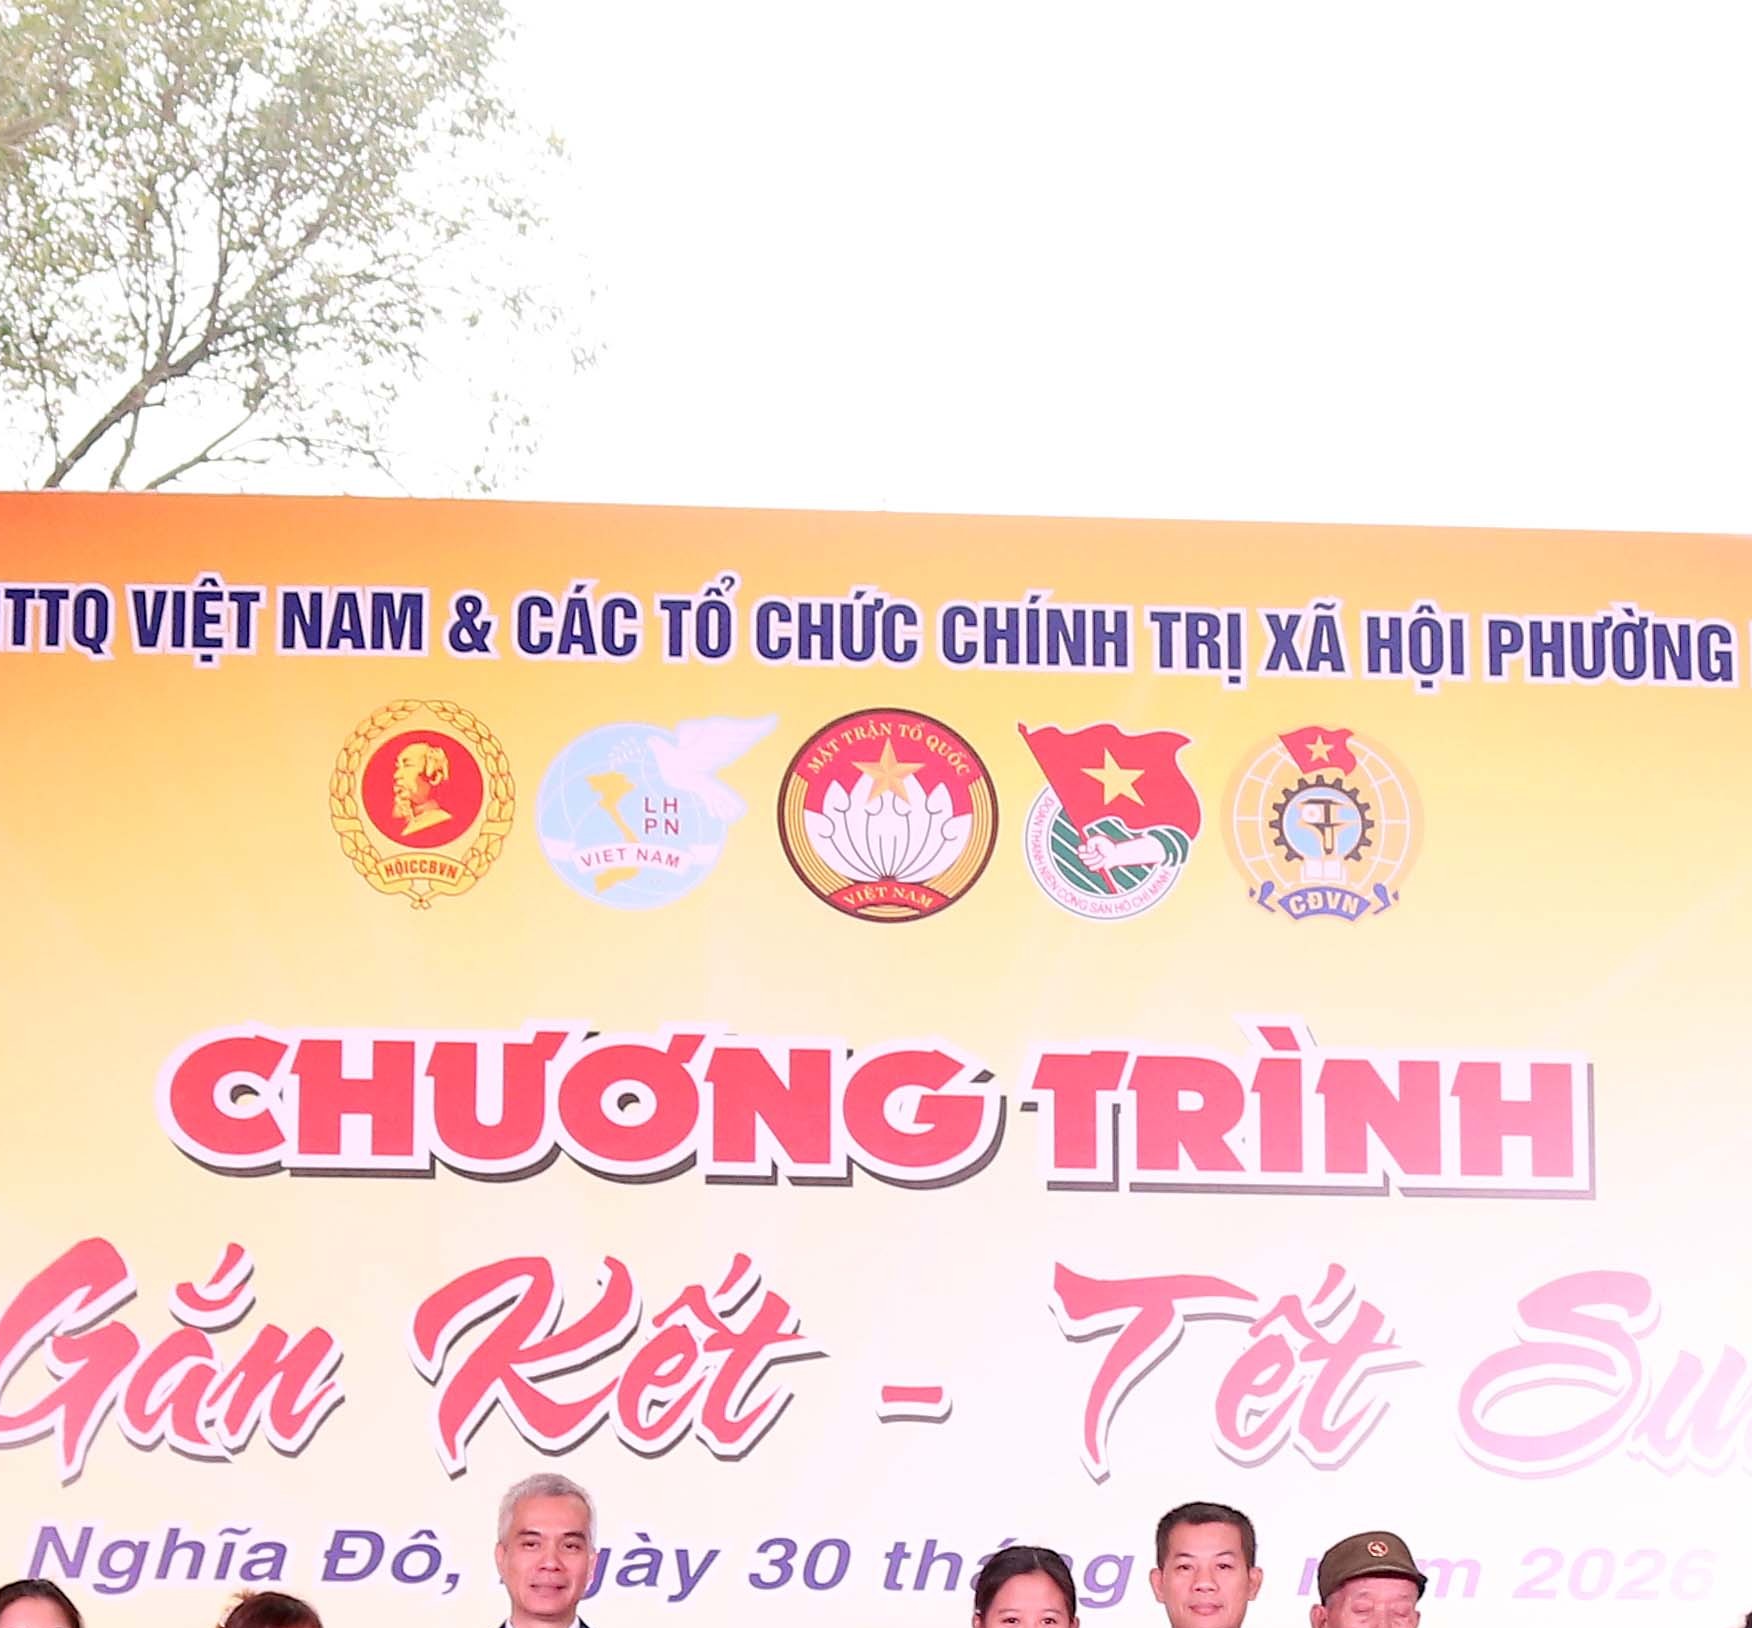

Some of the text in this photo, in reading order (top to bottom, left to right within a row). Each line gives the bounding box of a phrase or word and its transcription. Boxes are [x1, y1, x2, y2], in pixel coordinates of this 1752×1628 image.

[132, 577, 261, 662] VIỆT
[281, 591, 424, 650] NAM
[448, 594, 493, 654] &
[517, 583, 638, 656] CÁC
[660, 574, 736, 659] TỔ
[755, 590, 918, 663] CHỨC
[942, 594, 1129, 668] CHÍNH
[1150, 610, 1242, 685] TRỊ
[1265, 601, 1347, 673] XÃ
[1367, 604, 1464, 689] HỘI
[1488, 607, 1734, 682] PHƯỜNG
[636, 849, 681, 869] NAM
[843, 886, 934, 908] VIỆT NAM
[1288, 890, 1359, 915] CĐVN
[164, 1026, 1586, 1188] CHƯƠNG TRÌNH
[408, 1251, 820, 1472] Kết
[1051, 1262, 1413, 1475] Tết
[27, 1526, 289, 1595] Nghĩa
[321, 1529, 461, 1594] Đô,
[748, 1537, 851, 1591] 30
[1512, 1547, 1718, 1601] 2026
